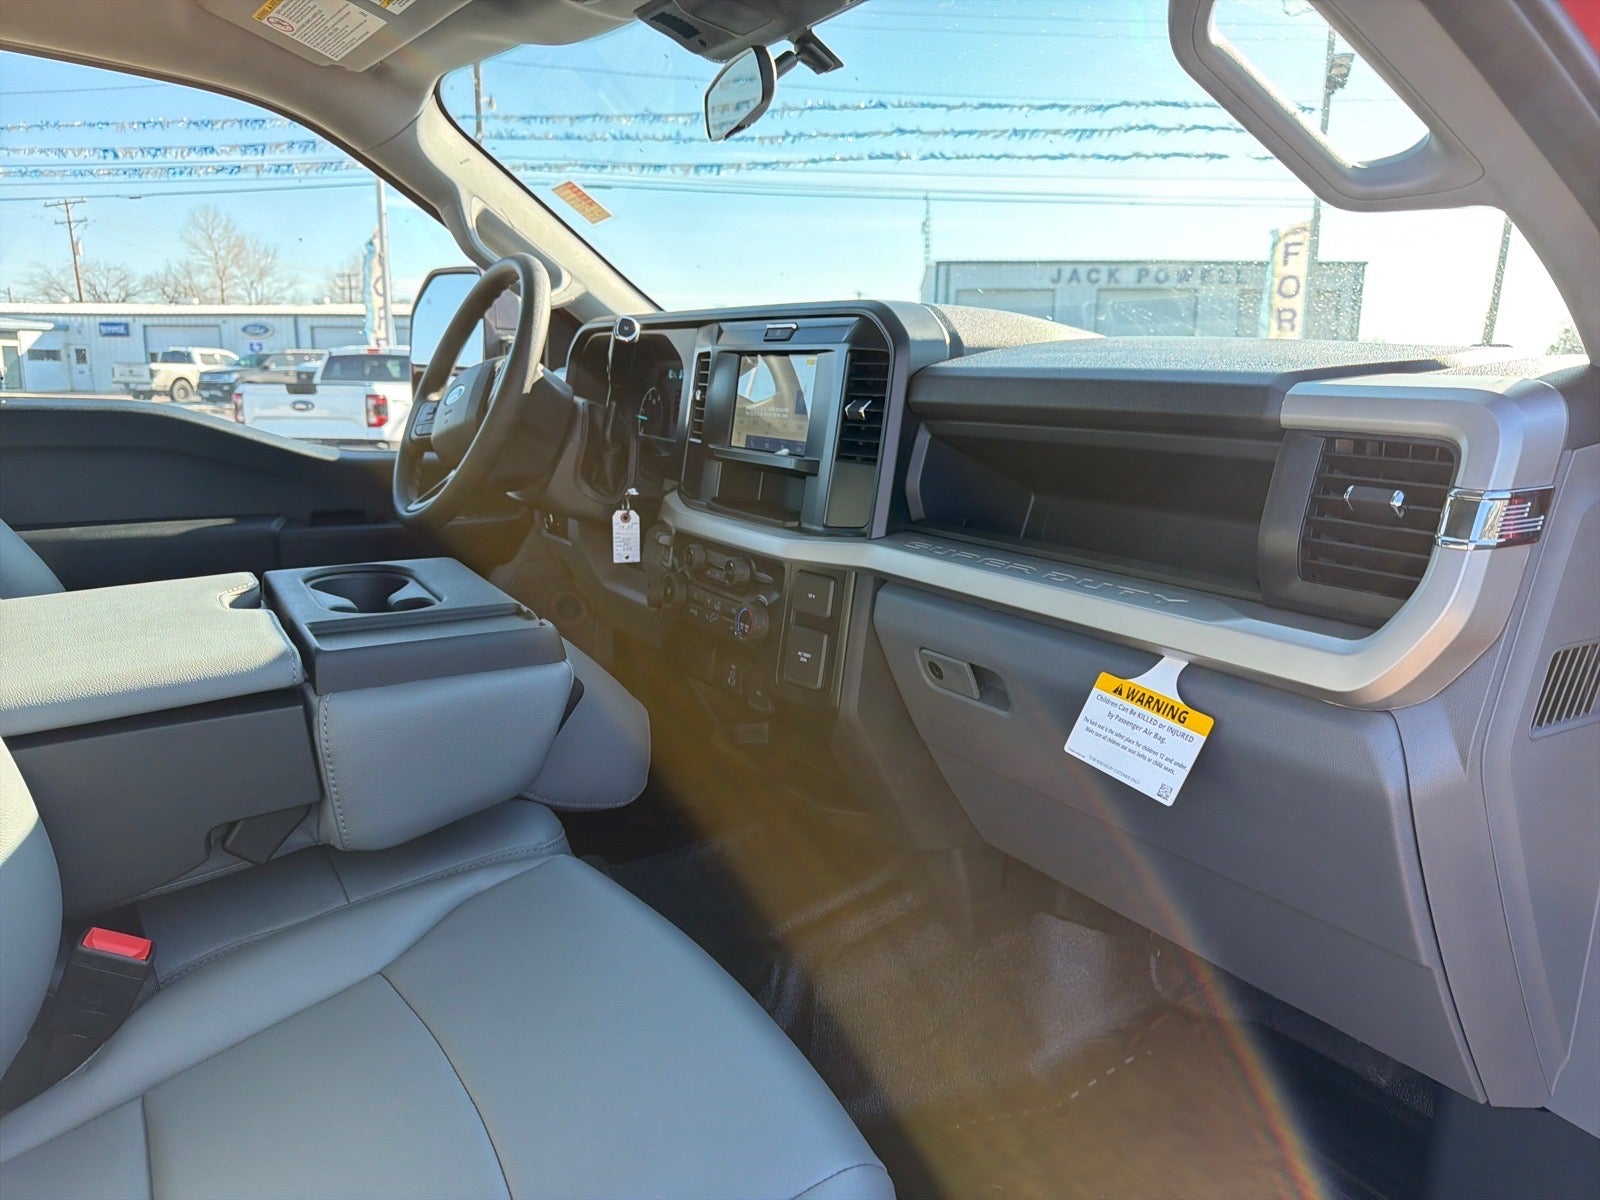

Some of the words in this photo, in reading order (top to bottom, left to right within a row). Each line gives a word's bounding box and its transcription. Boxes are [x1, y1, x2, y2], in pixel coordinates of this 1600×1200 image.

[1050, 268, 1121, 285] JACK
[1136, 267, 1248, 285] POWELL
[904, 540, 1037, 574] SUPER
[1042, 570, 1190, 604] DUTY
[1096, 694, 1118, 709] Children
[1118, 703, 1129, 714] Can
[1129, 710, 1137, 718] Be
[1137, 712, 1158, 726] KILLED
[1166, 726, 1195, 743] INJURED
[1126, 686, 1189, 724] WARNING
[1107, 711, 1116, 721] by
[1115, 714, 1144, 732] Passenger
[1143, 728, 1153, 737] Air
[1153, 733, 1167, 745] Bag.
